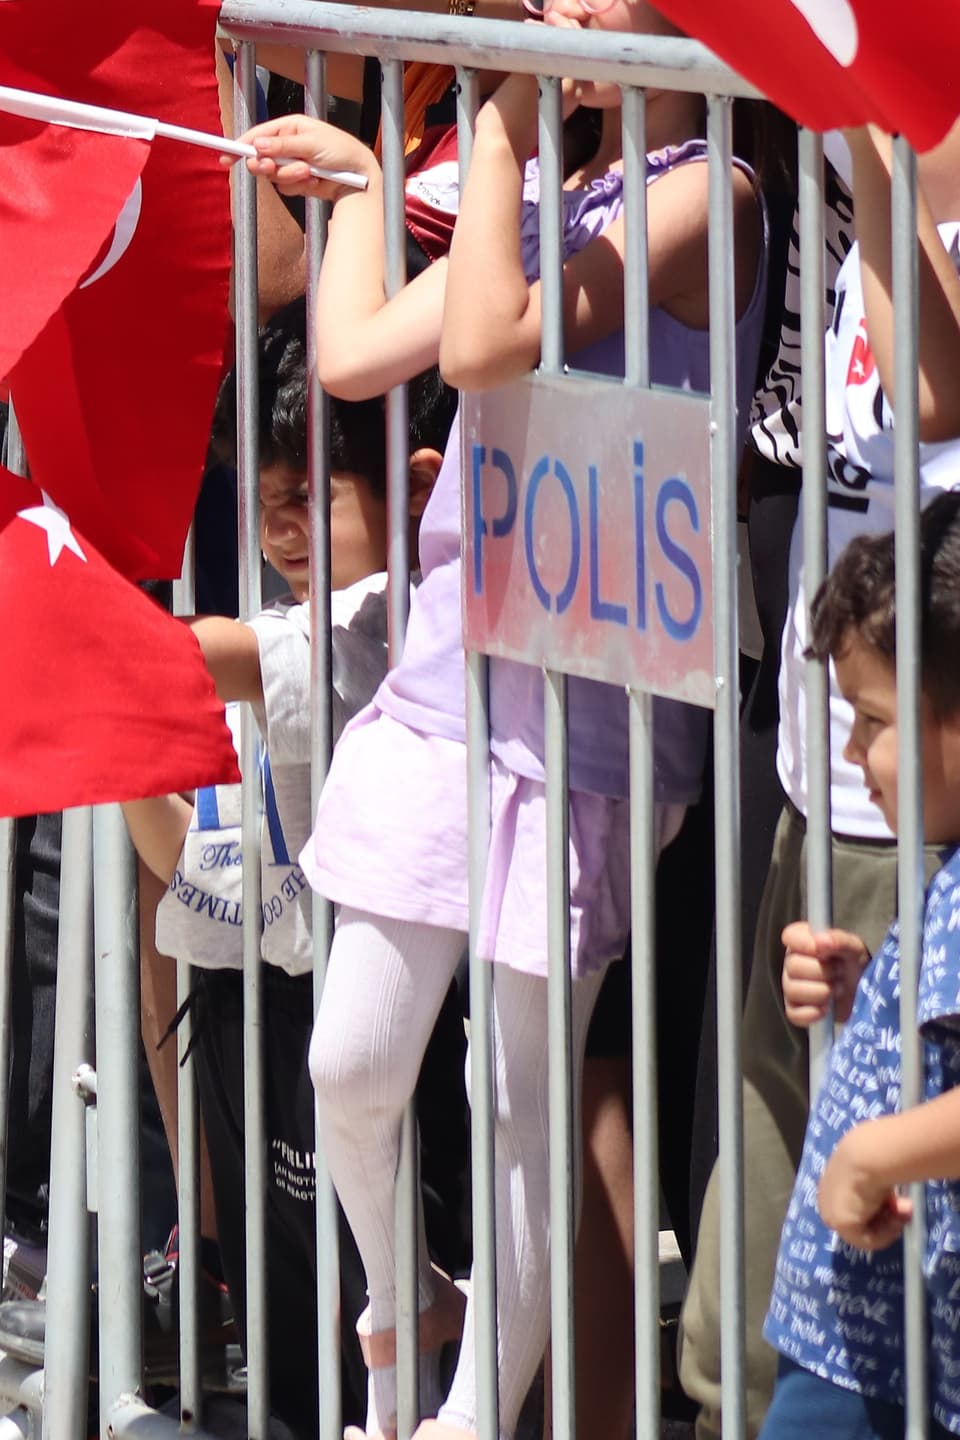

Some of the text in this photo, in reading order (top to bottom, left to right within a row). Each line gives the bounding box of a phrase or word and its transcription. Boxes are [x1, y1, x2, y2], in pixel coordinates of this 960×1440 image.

[471, 440, 703, 643] POLİS
[171, 871, 243, 926] TIMES
[281, 870, 306, 902] HE
